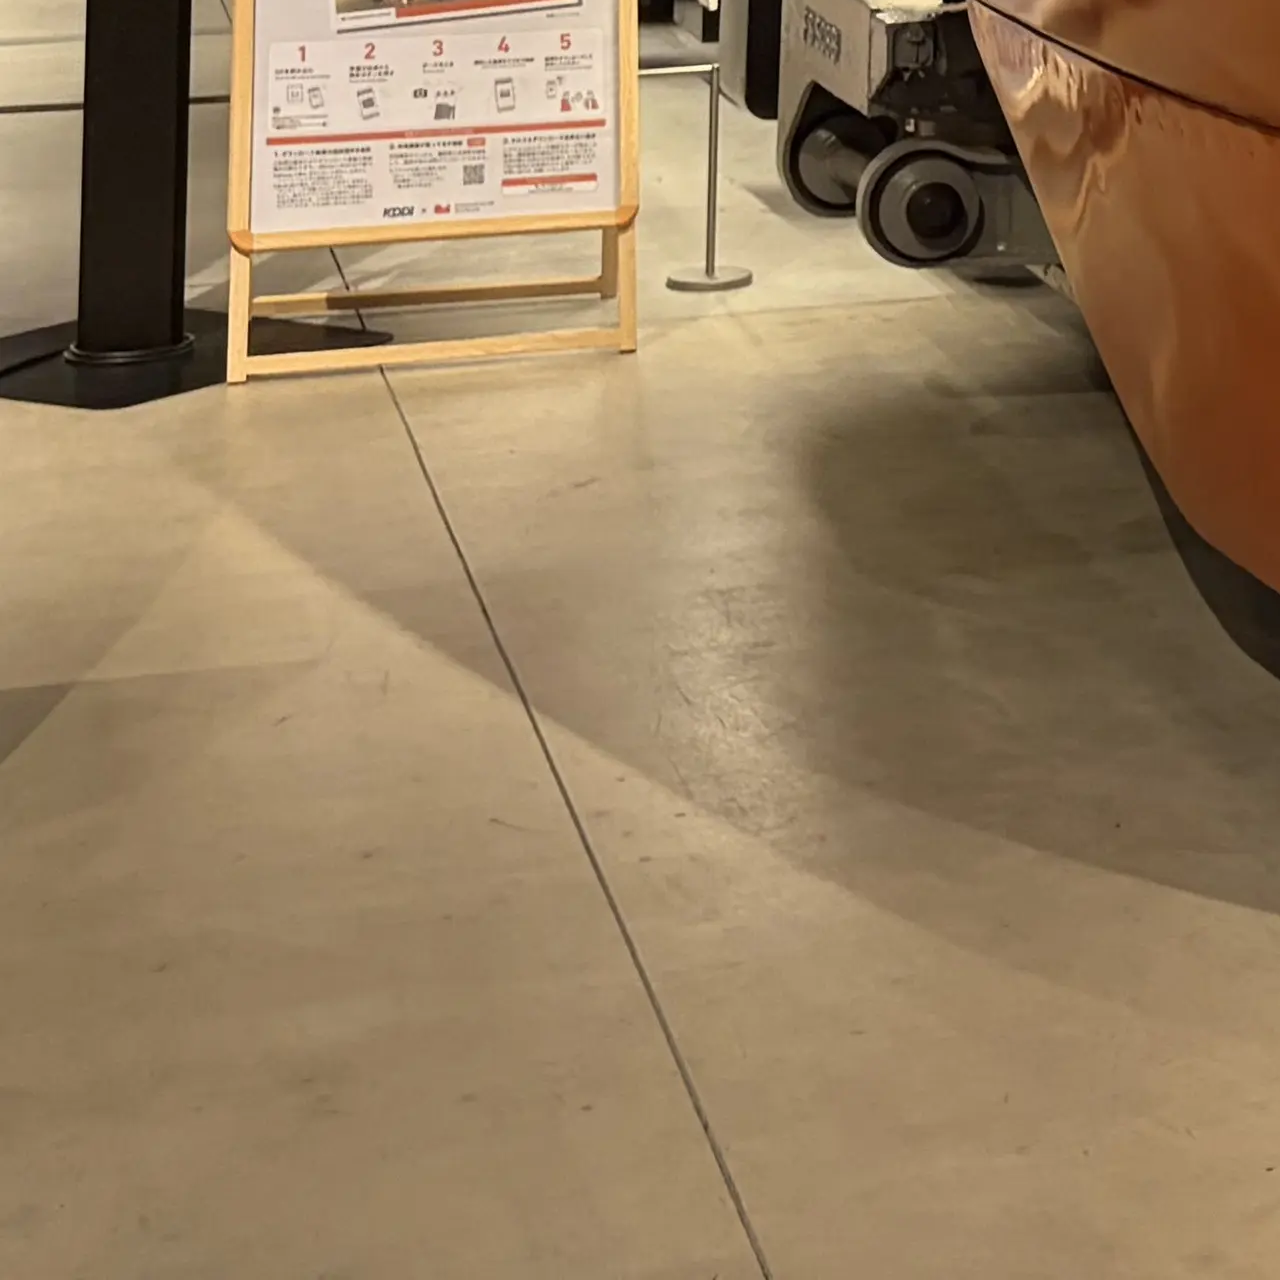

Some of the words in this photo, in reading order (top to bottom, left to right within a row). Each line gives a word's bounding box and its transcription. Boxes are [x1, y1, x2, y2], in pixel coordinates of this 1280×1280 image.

[432, 40, 444, 56] 3
[497, 36, 510, 53] 4
[560, 33, 572, 50] 5
[298, 45, 306, 62] 1
[364, 42, 376, 59] 2
